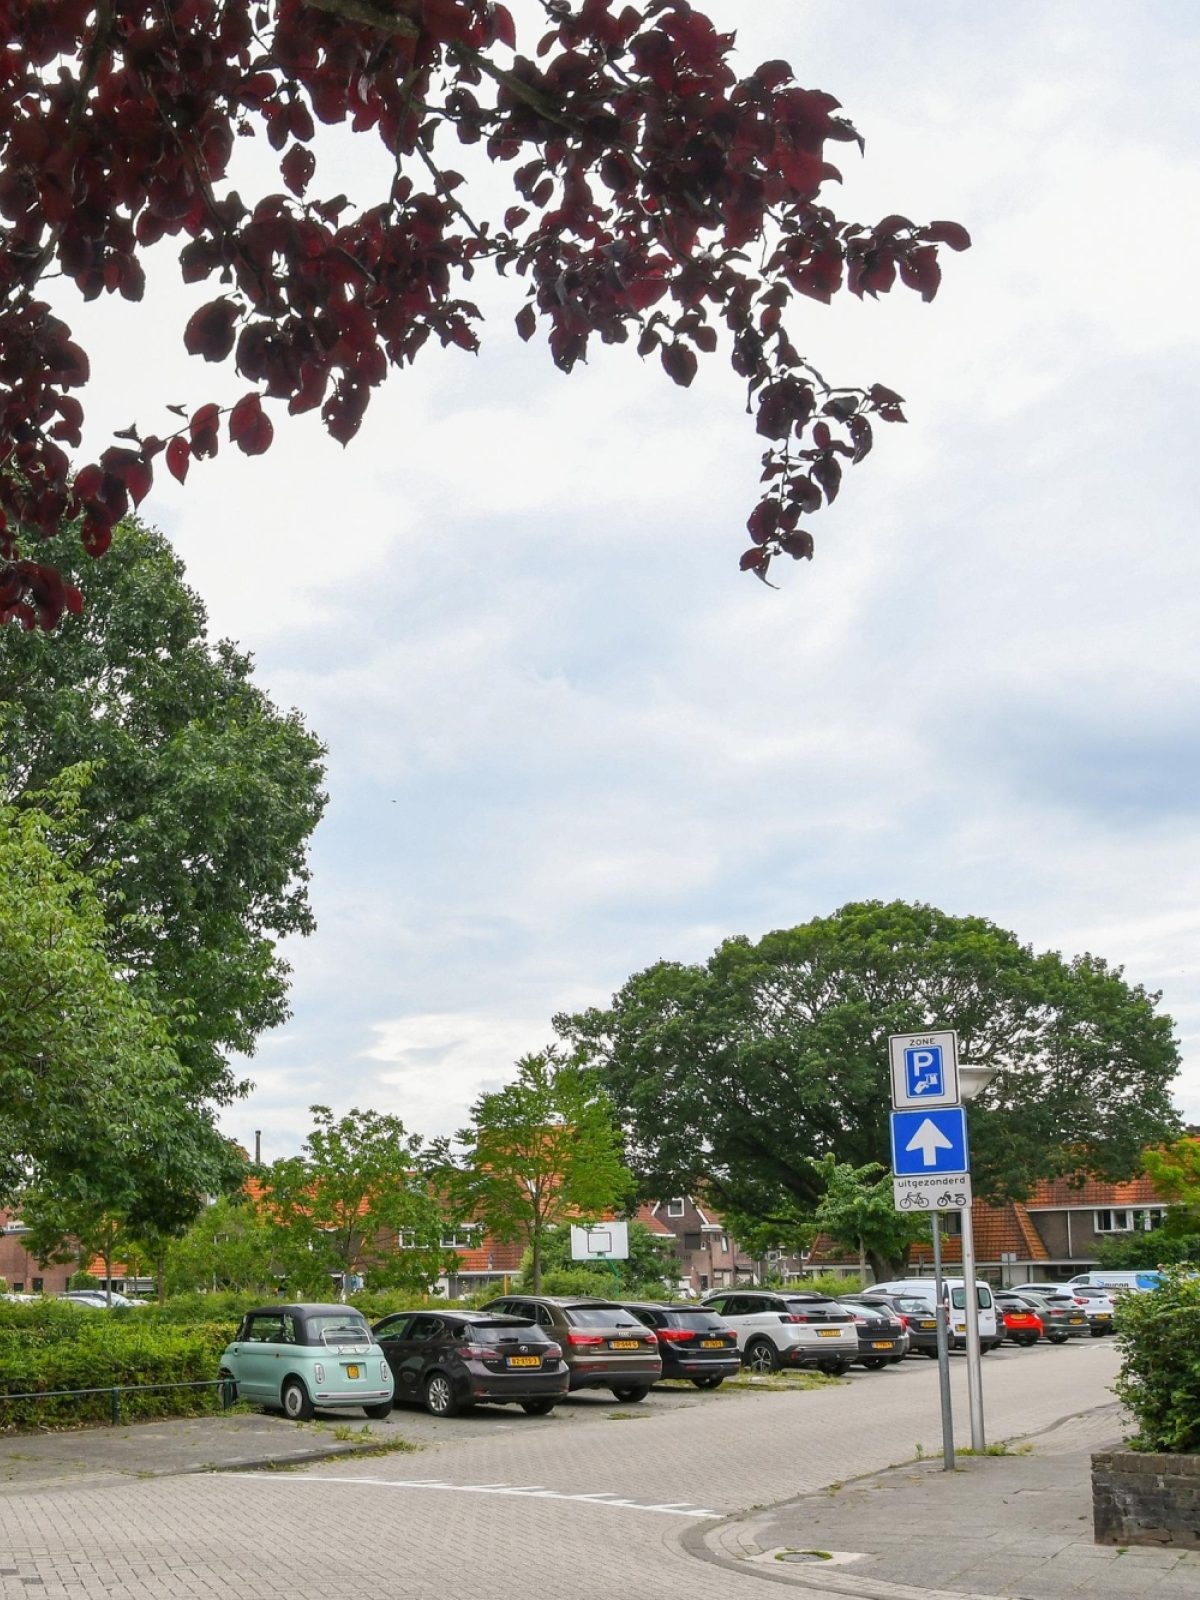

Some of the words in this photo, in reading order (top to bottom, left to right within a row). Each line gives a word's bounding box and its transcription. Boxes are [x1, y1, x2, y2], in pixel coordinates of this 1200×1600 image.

[910, 1038, 935, 1046] ZONE
[913, 1052, 933, 1077] P
[898, 1176, 966, 1189] uitgezonderd
